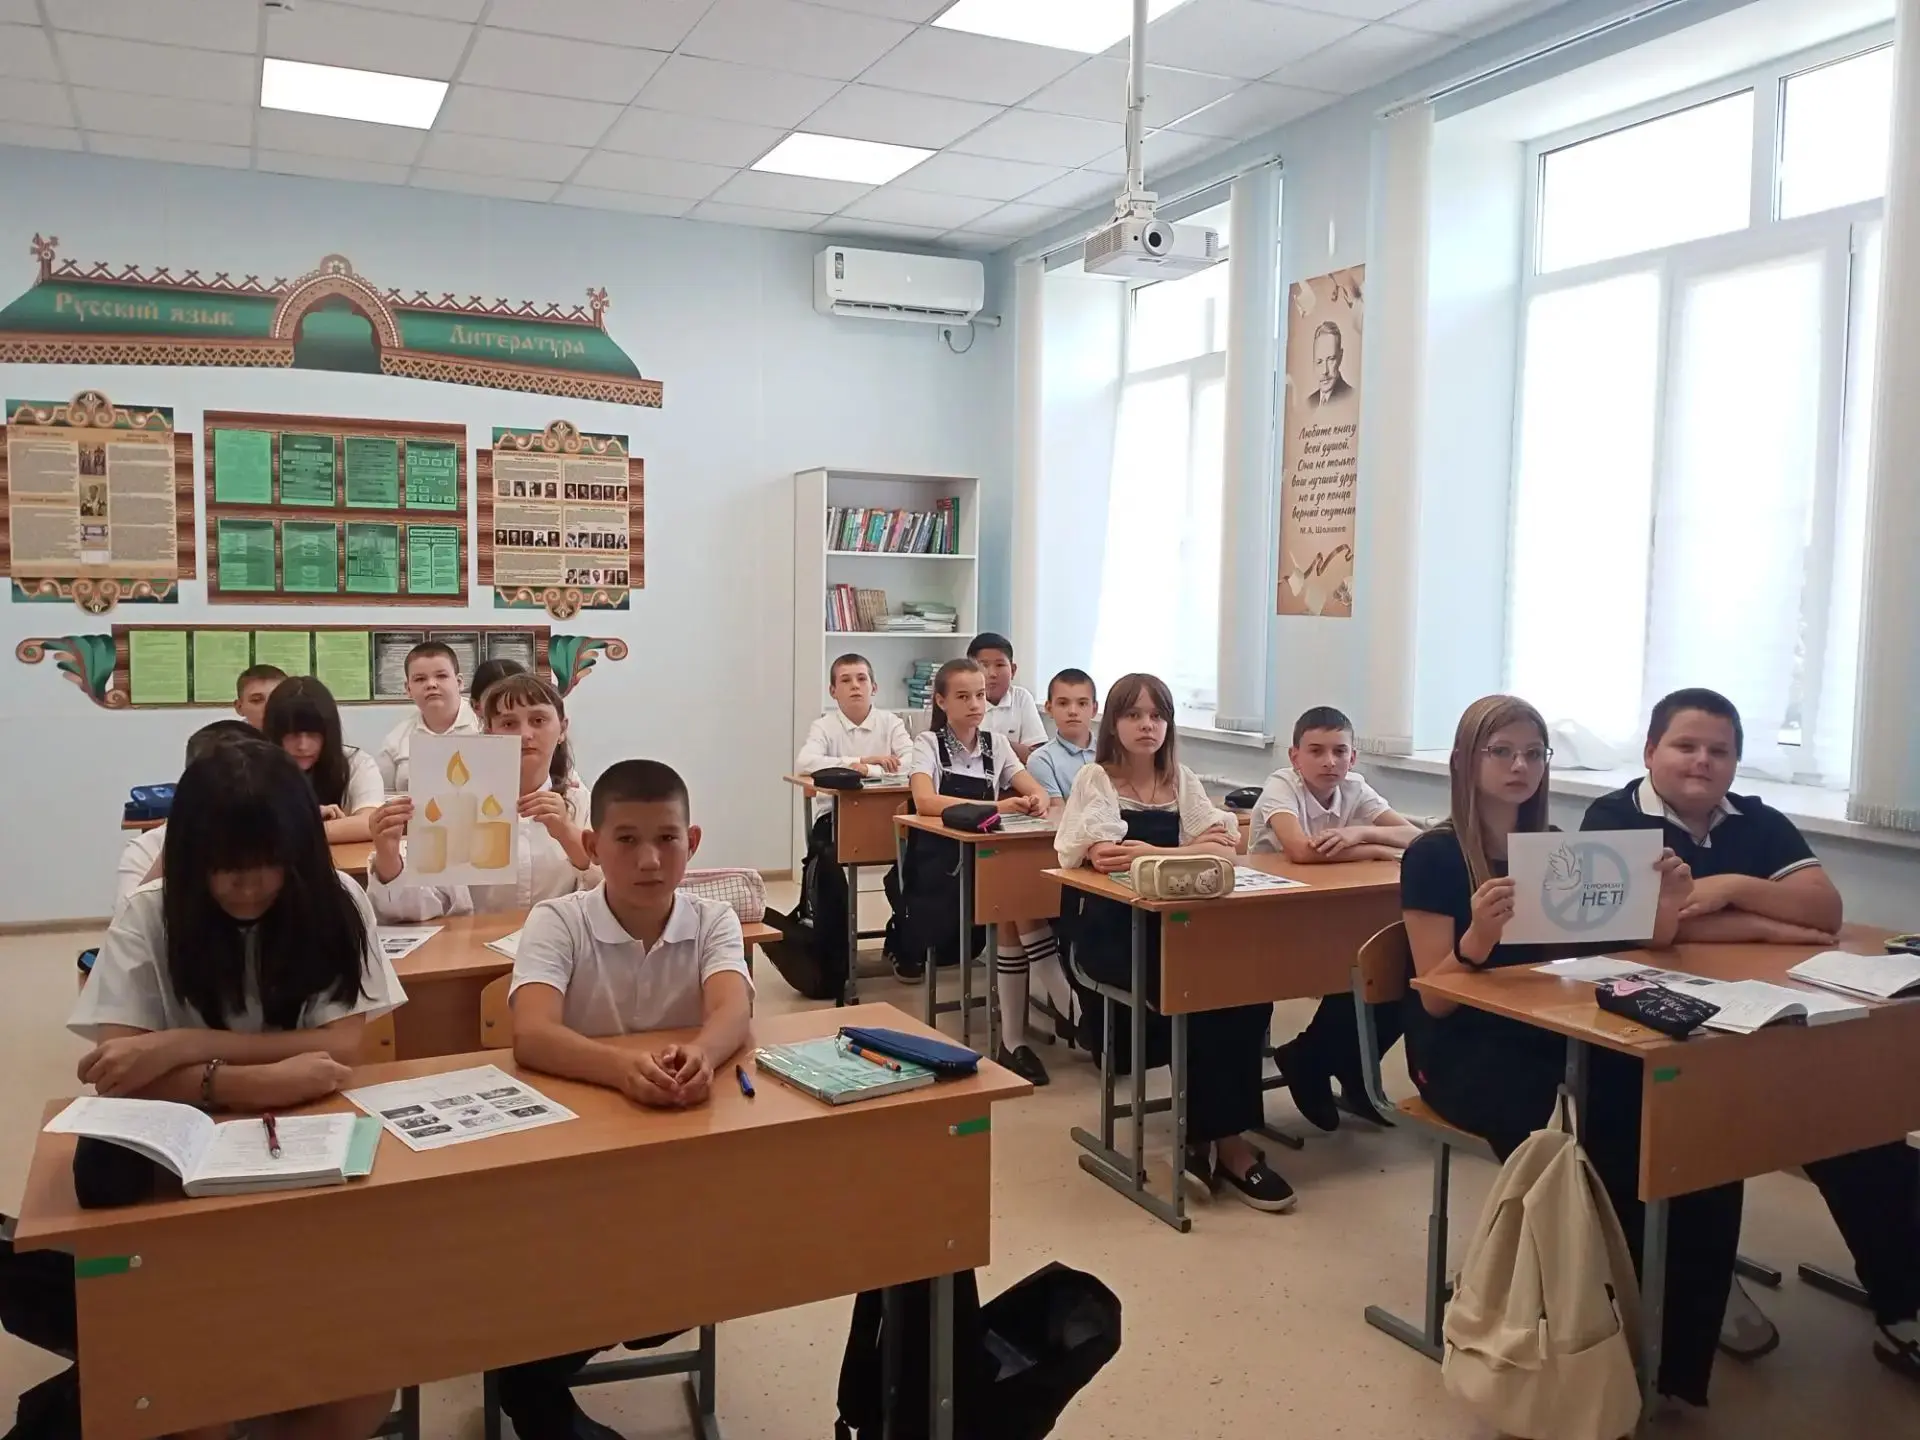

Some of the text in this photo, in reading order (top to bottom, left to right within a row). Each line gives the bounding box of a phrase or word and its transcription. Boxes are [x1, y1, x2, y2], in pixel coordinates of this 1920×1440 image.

[55, 292, 235, 326] Русский язык
[450, 324, 586, 358] Литература
[1299, 424, 1356, 440] Любите книгу
[1304, 441, 1321, 454] всей
[1298, 457, 1355, 471] Она не только
[1291, 474, 1307, 487] ваш
[1308, 472, 1339, 490] лучший
[1299, 490, 1351, 506] но и до конца
[1292, 506, 1319, 522] верный
[1582, 890, 1624, 906] НЕТ!
